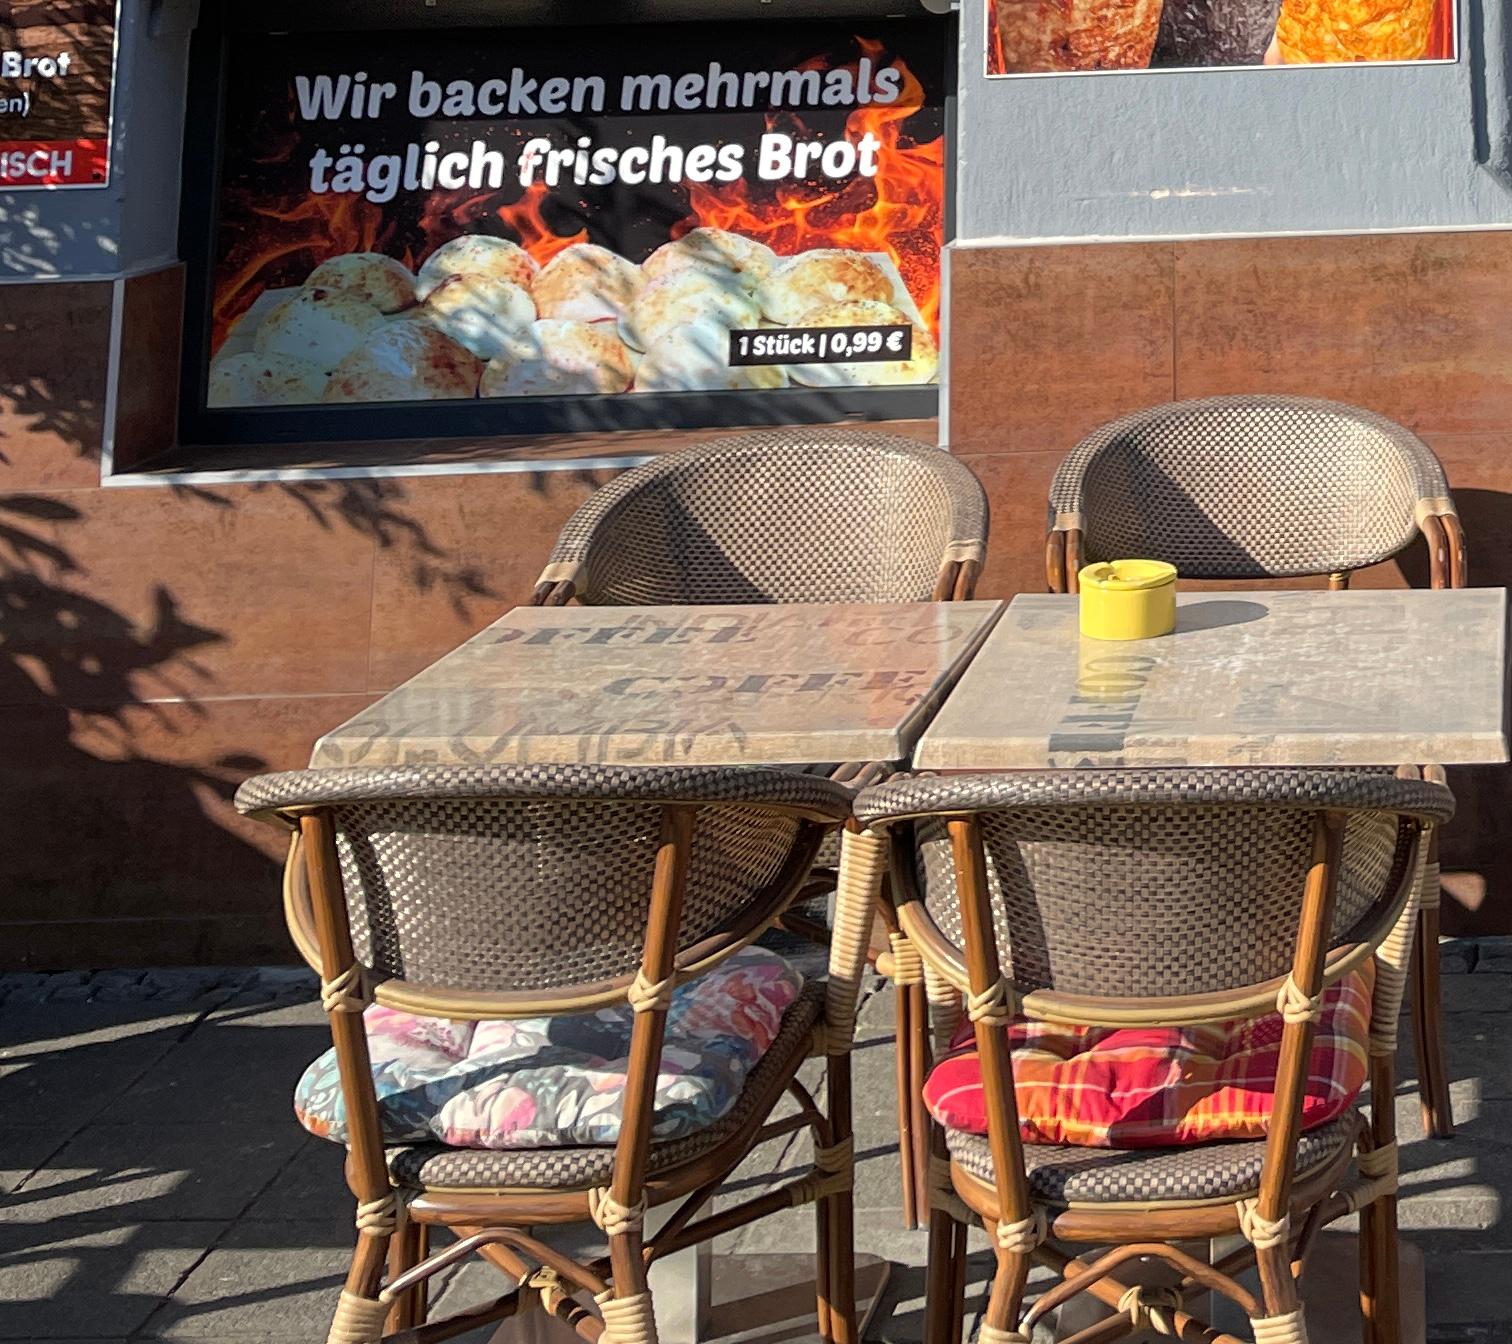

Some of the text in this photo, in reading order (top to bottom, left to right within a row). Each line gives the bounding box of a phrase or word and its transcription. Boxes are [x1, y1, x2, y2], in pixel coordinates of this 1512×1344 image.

[2, 51, 72, 78] Brot
[296, 58, 901, 121] Wir backen mehrmals
[309, 130, 881, 204] täglich frisches Brot
[739, 336, 749, 356] 1
[752, 333, 816, 356] Stück
[830, 331, 884, 358] 0,99
[886, 330, 904, 352] €
